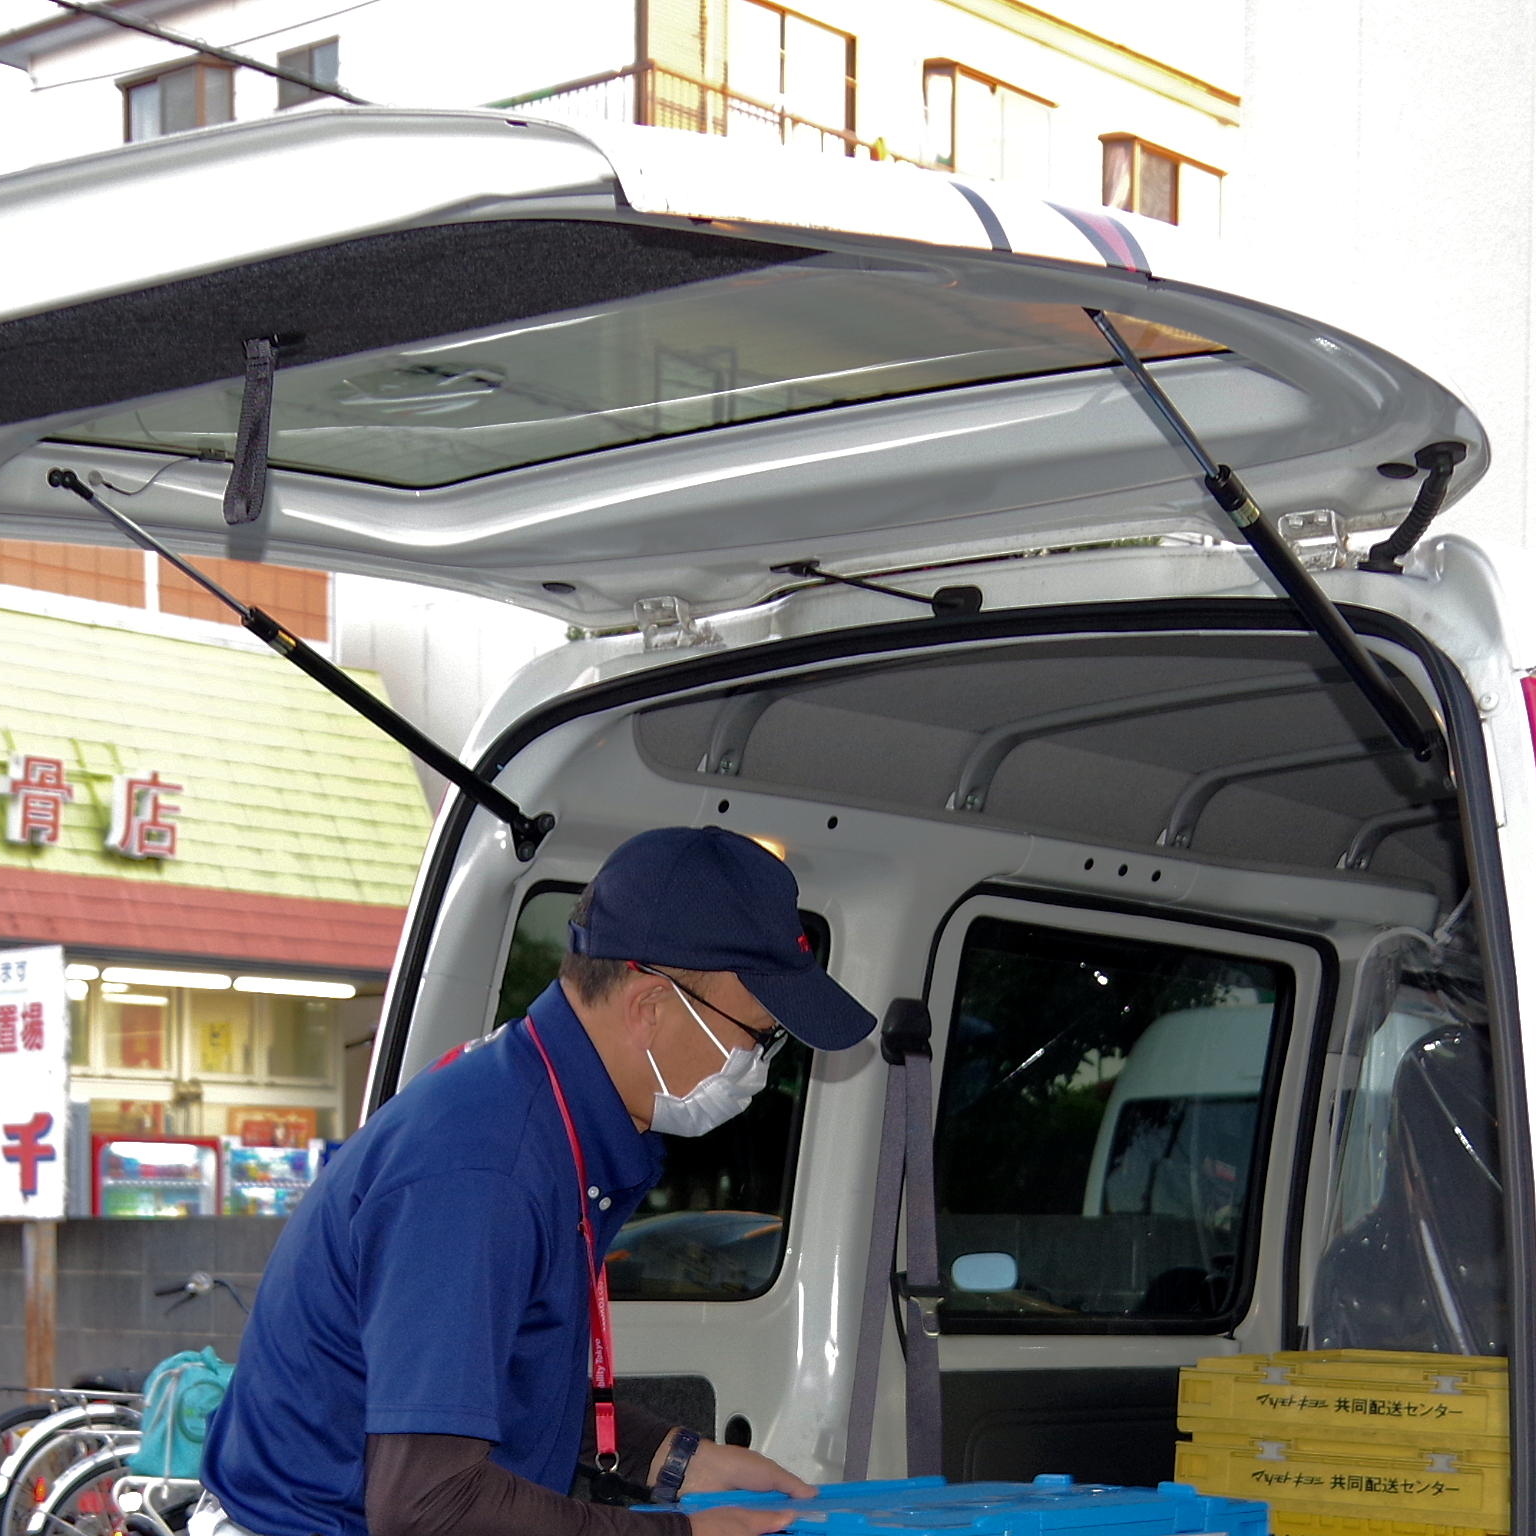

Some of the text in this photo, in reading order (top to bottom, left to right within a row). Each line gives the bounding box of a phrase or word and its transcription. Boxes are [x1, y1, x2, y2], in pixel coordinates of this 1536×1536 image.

[1335, 1397, 1463, 1418] 共同配送センター
[1330, 1474, 1460, 1496] 共同配送センター
